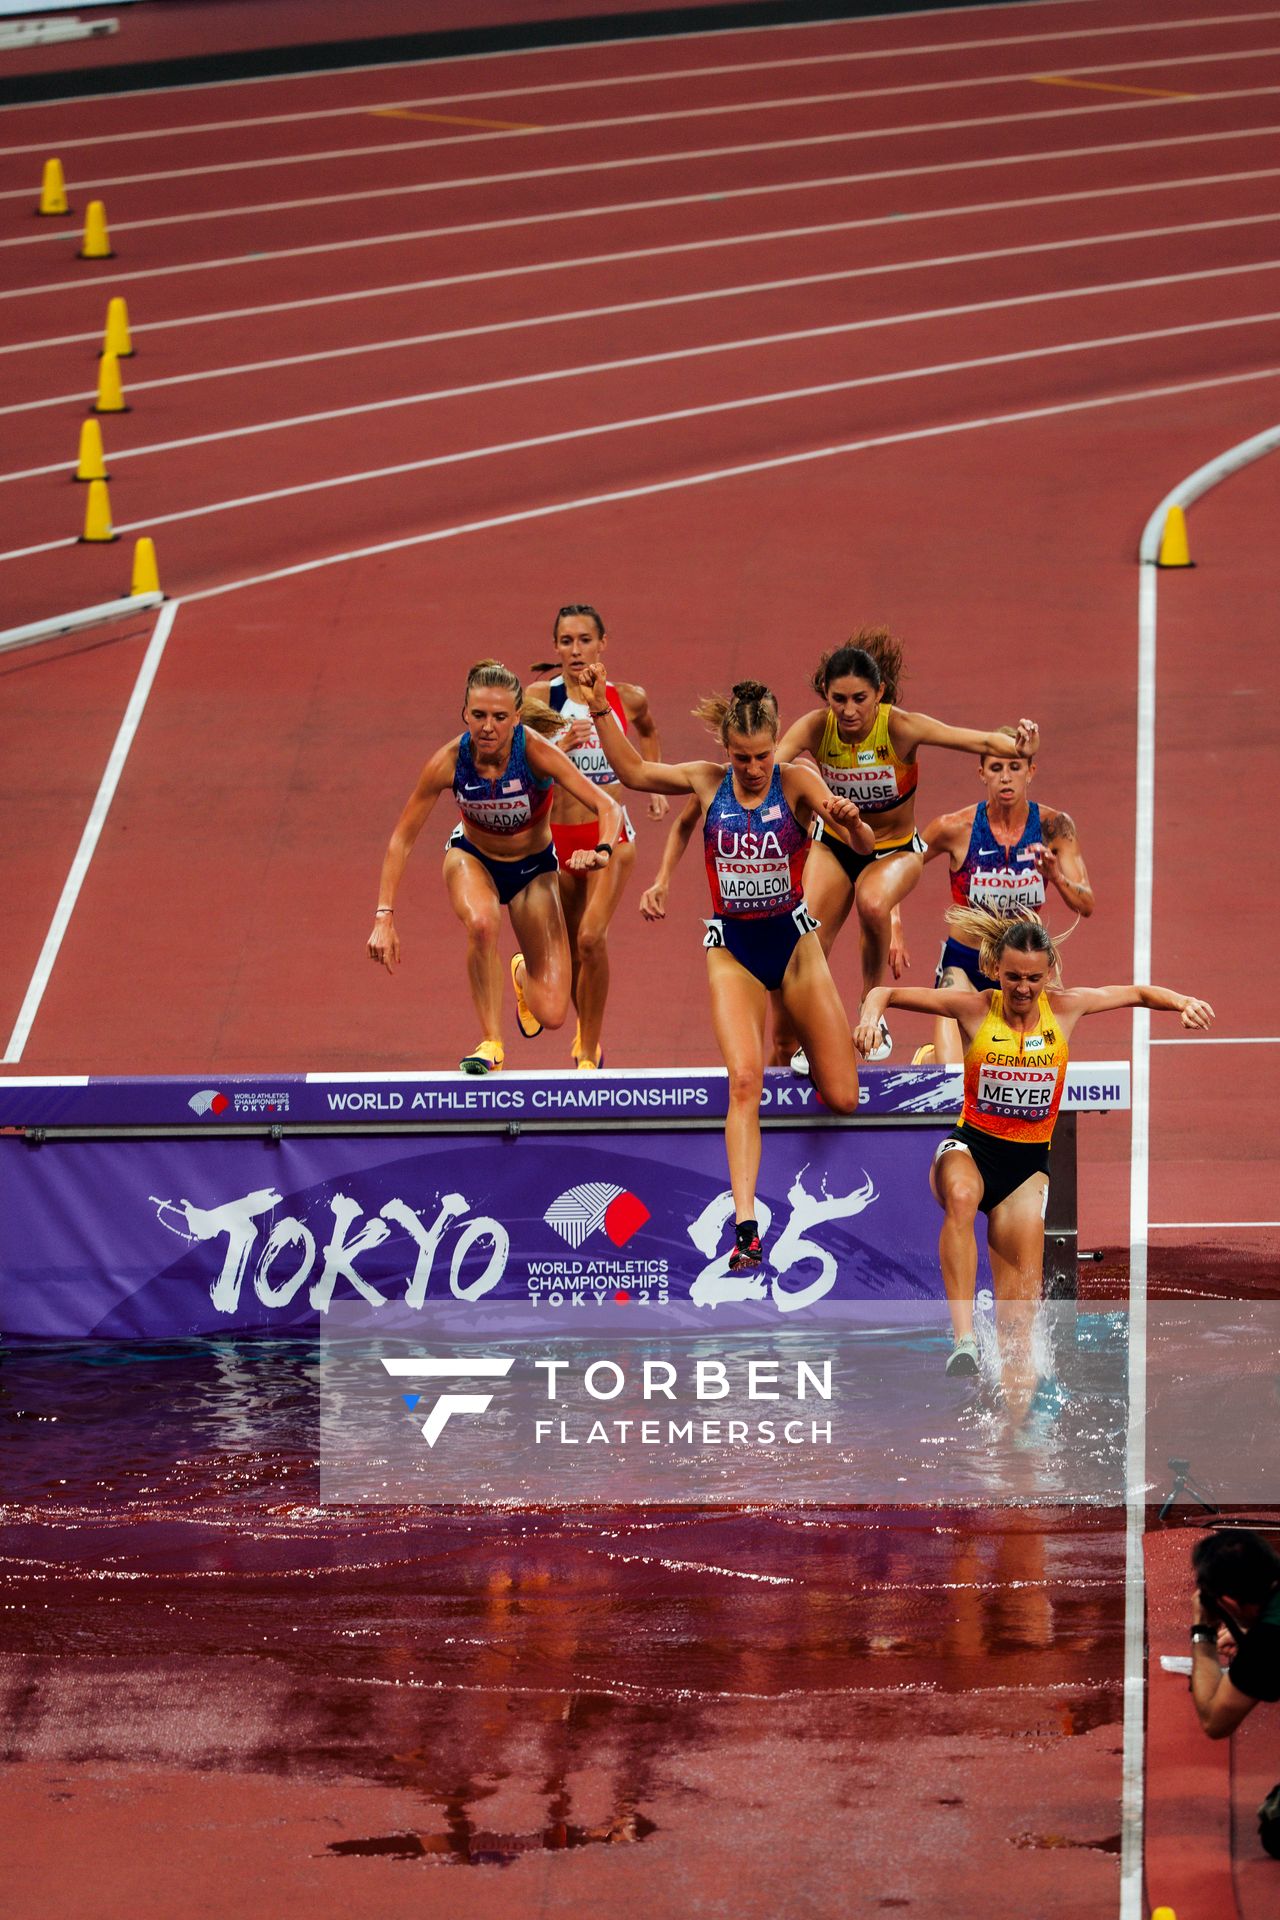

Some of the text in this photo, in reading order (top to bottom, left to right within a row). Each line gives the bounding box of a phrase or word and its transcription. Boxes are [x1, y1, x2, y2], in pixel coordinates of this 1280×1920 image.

[858, 753, 876, 761] WGV
[822, 766, 893, 782] HONDA
[717, 829, 783, 860] USA
[718, 862, 789, 874] HONDA
[720, 876, 790, 897] NAPOLEON
[973, 875, 1041, 889] HONDA
[1025, 1039, 1043, 1048] WGV
[986, 1052, 1055, 1068] GERMANY
[982, 1069, 1056, 1083] HONDA
[327, 1088, 709, 1111] WORLD ATHLETICS CHAMPIONSHIPS
[983, 1084, 1051, 1105] MEYER
[1067, 1085, 1120, 1101] NISHI
[149, 1163, 880, 1314] TOKYO 25
[527, 1260, 669, 1275] WORLD ATHLETICS
[527, 1274, 669, 1290] CHAMPIONSHIPS
